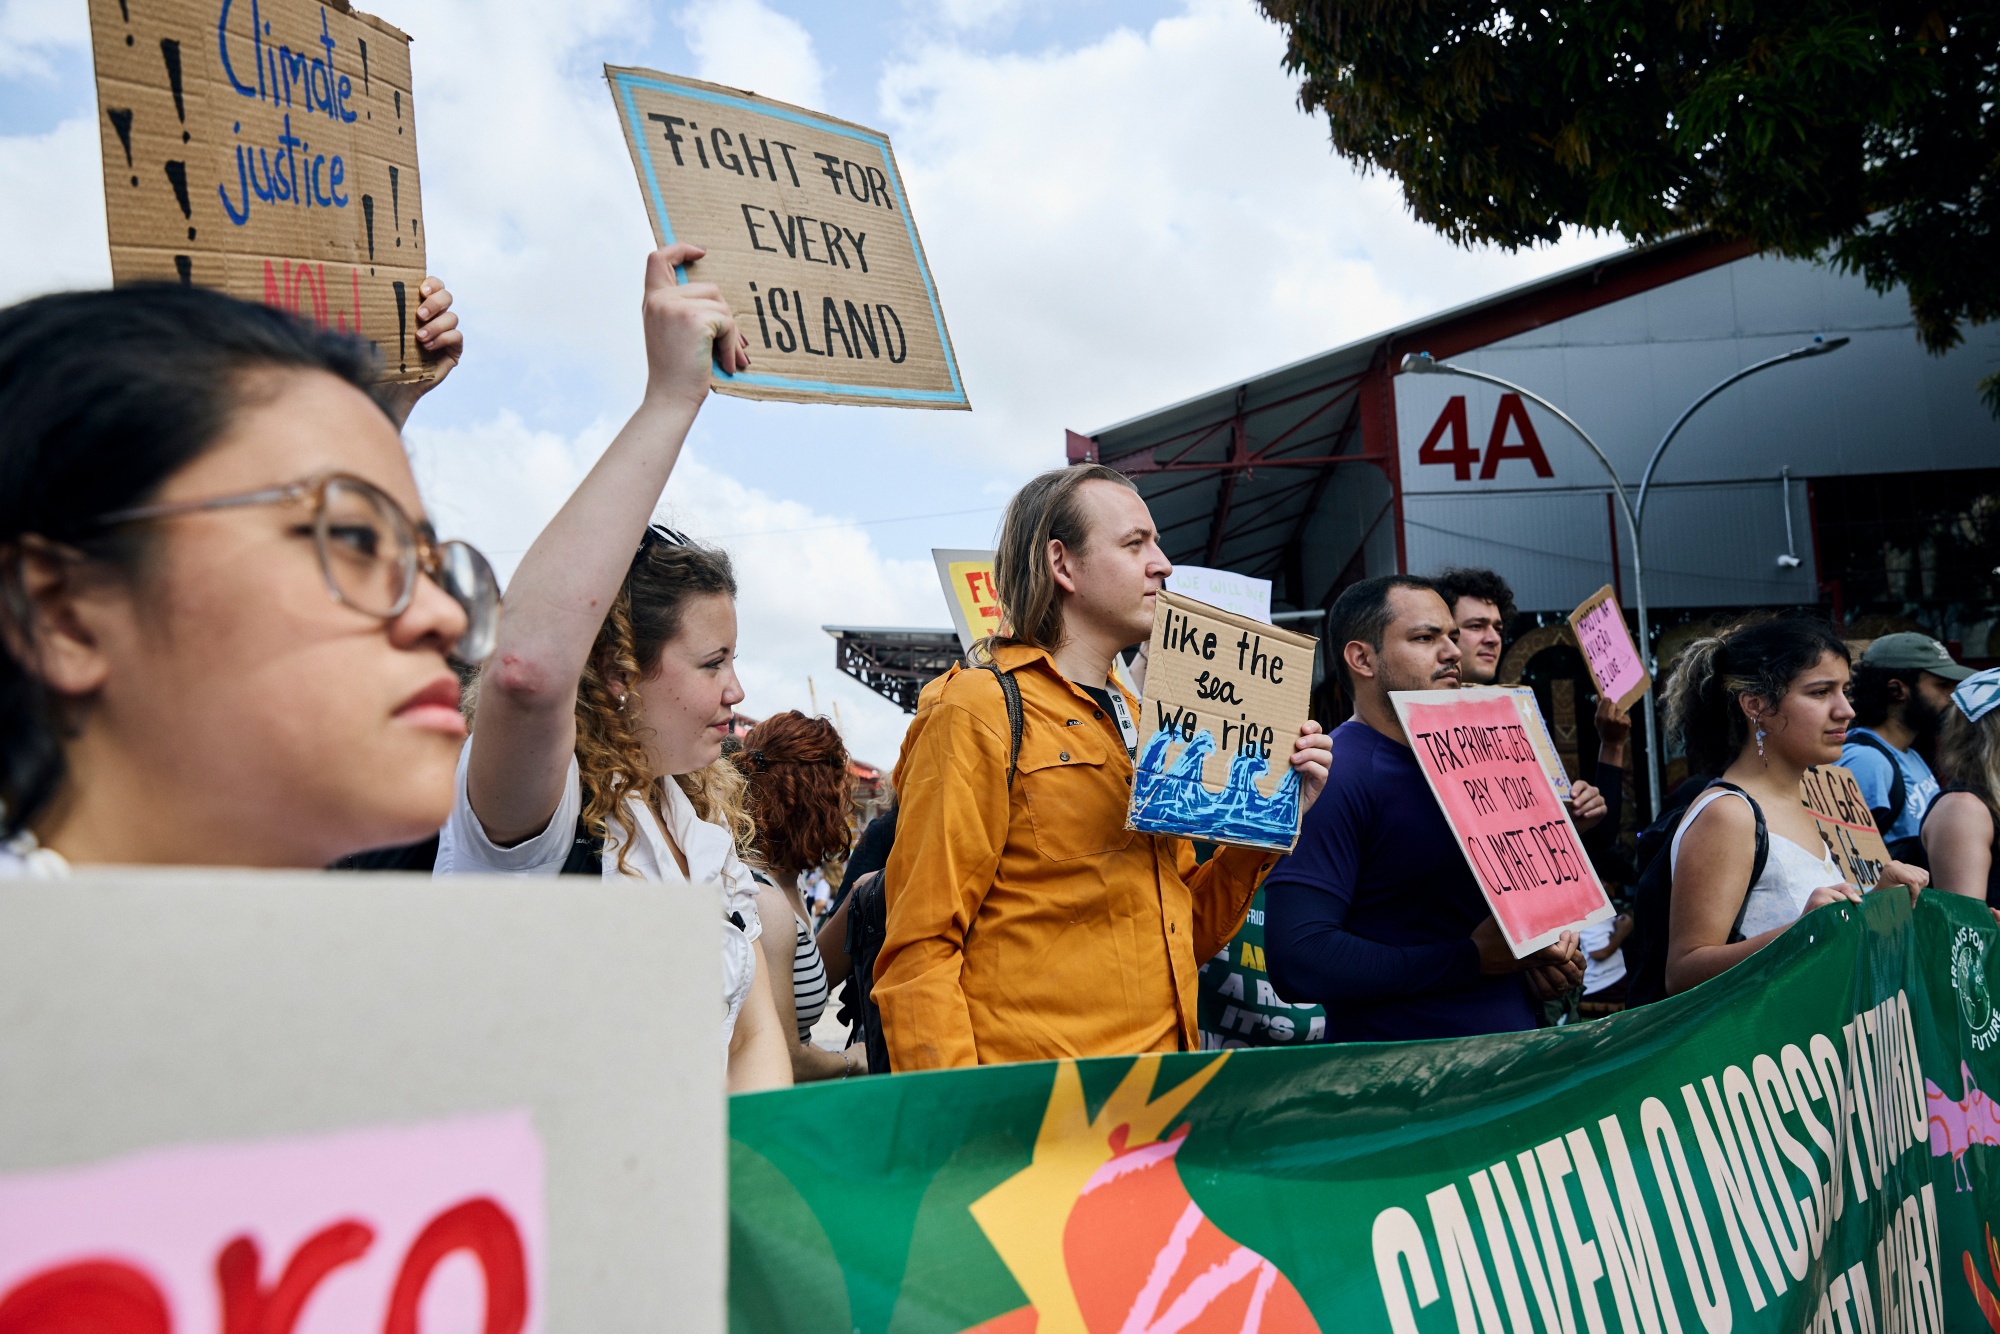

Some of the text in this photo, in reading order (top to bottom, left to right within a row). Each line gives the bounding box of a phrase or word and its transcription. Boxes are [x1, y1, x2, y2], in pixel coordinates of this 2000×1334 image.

[218, 0, 357, 124] Climate
[218, 113, 348, 226] justice
[813, 151, 893, 210] FOR
[741, 203, 869, 273] EVERY
[1418, 393, 1555, 481] 4A
[1163, 609, 1284, 684] like the
[1194, 671, 1243, 705] sea
[1157, 700, 1274, 759] we rise
[1417, 724, 1536, 775] TAX PRIVATE JETS
[1463, 776, 1539, 816] PAY YOUR
[1826, 770, 1872, 828] GAS
[1467, 820, 1587, 896] CLIMATE DEBT
[1217, 971, 1245, 1001] A
[1951, 926, 1985, 989] FRIDAYS FOR
[1220, 1004, 1296, 1041] IT'S
[1971, 1007, 2000, 1051] FUTURE
[1640, 1096, 1732, 1334] O
